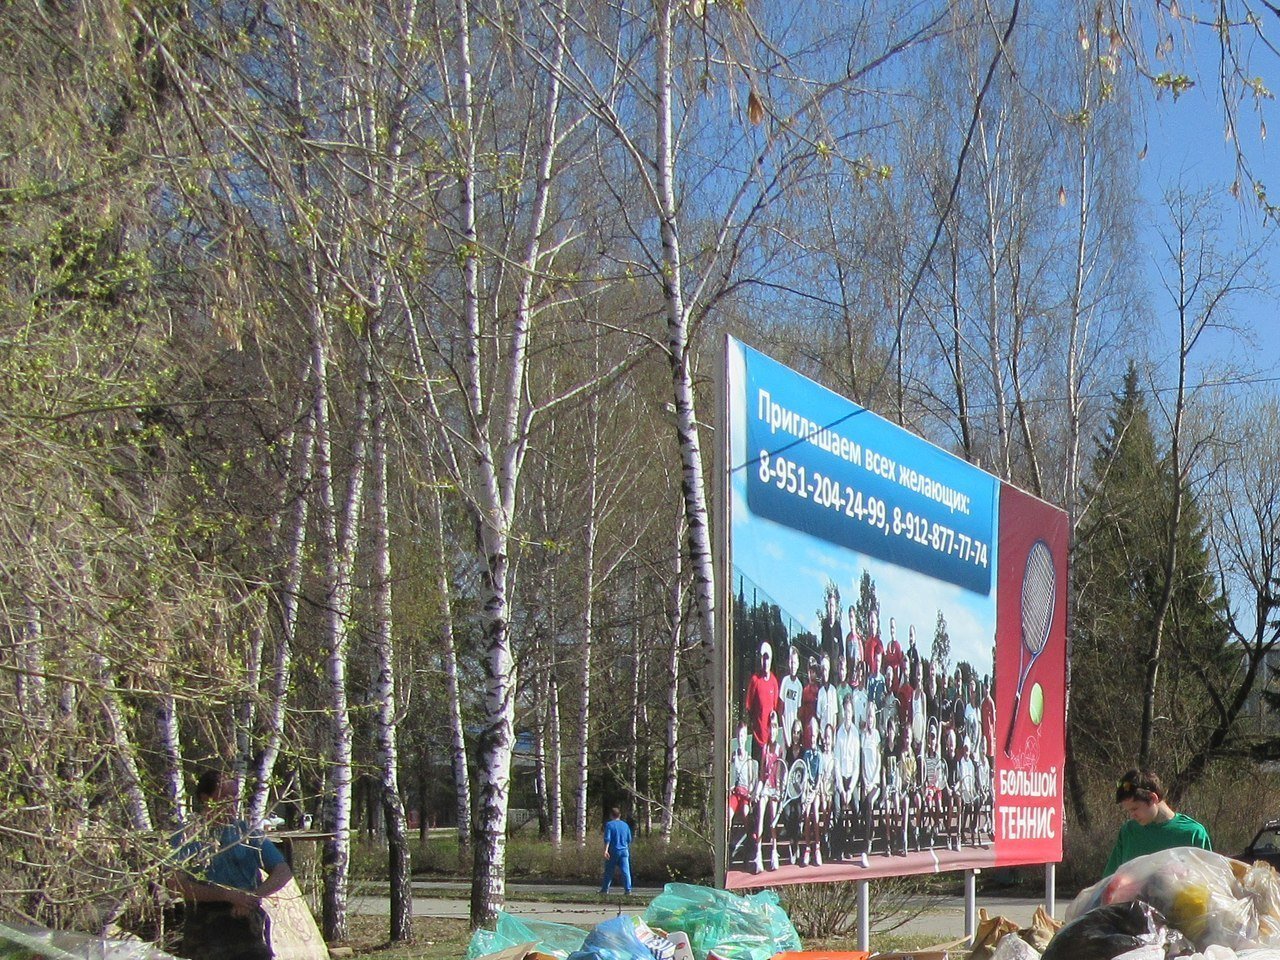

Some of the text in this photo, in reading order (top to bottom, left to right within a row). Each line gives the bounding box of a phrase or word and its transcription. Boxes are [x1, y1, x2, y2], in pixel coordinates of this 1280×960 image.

[758, 389, 970, 514] Приглашаем всех желающих:
[758, 450, 988, 569] 8-951-204-24-99, 8-912-877-77-74
[1000, 766, 1057, 798] БОЛЬШОЙ
[999, 806, 1056, 840] ТЕННИС
